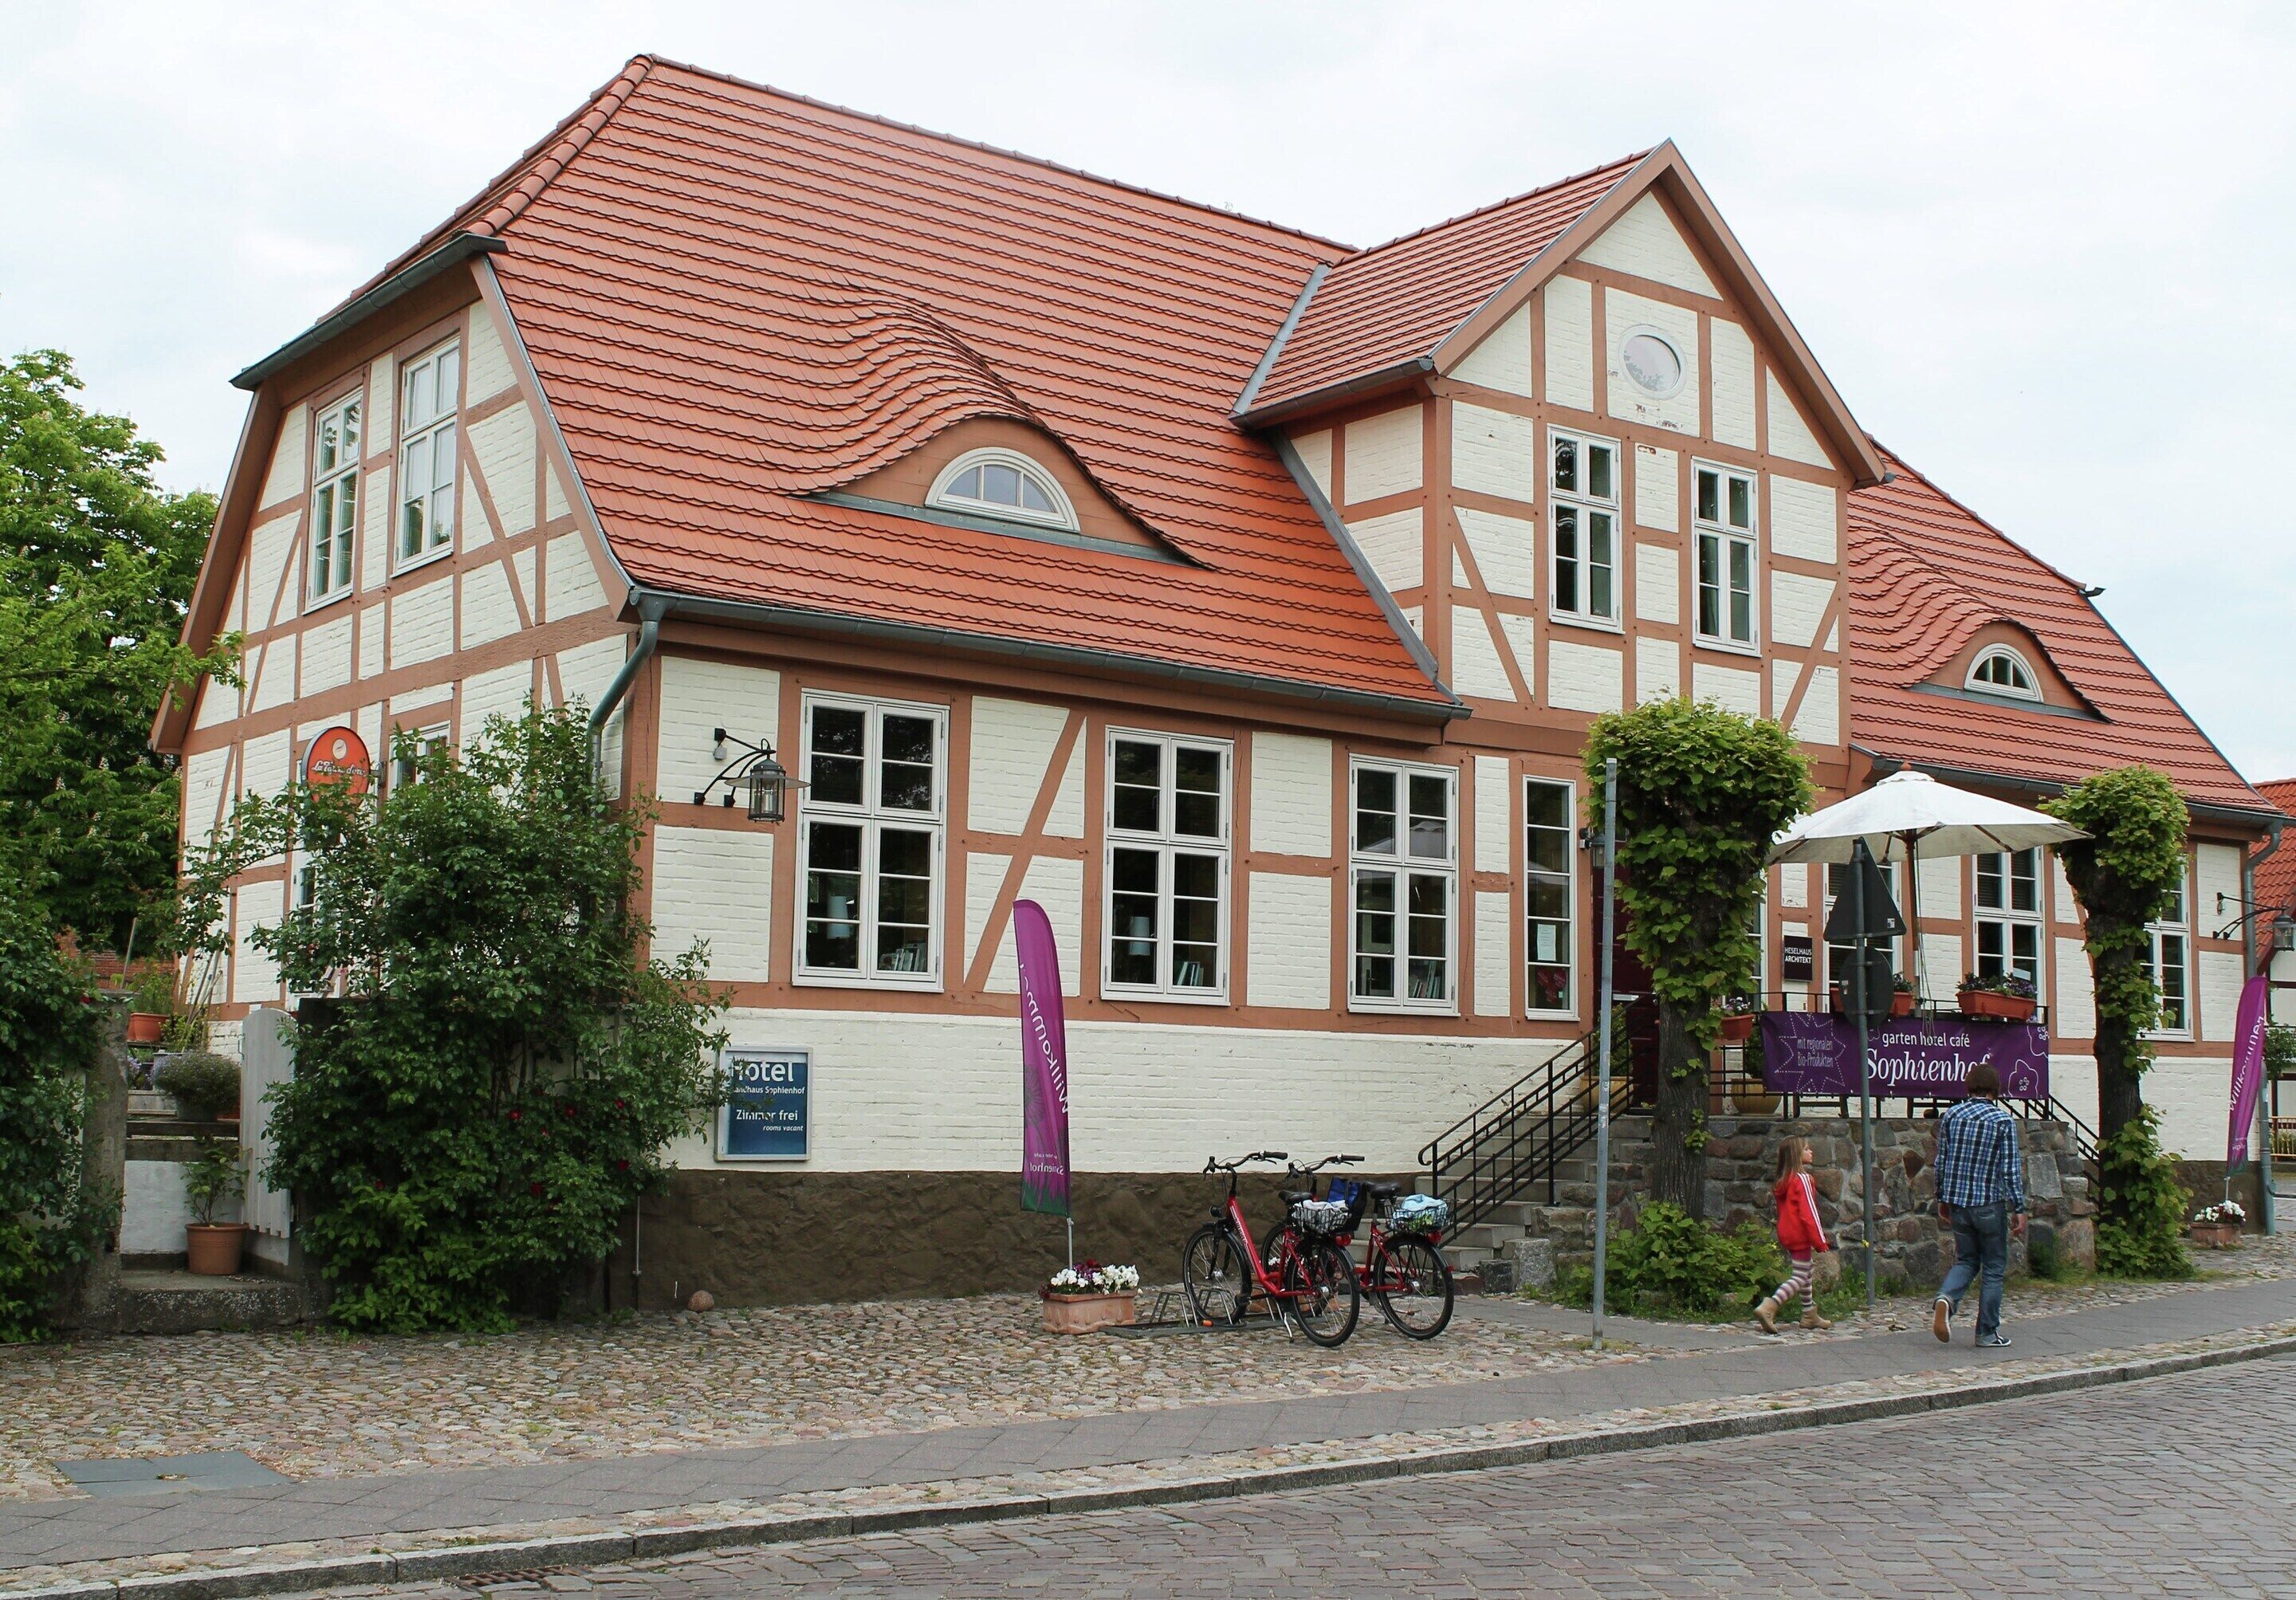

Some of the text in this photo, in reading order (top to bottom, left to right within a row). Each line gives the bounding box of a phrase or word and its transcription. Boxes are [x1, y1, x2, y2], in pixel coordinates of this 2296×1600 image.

[1784, 947, 1812, 956] HESELHAUS
[1807, 1036, 1833, 1054] regionalen
[1882, 1031, 1971, 1048] garten hotel café
[1798, 1052, 1834, 1067] Bio-Produkten
[733, 1085, 805, 1095] andhaus Sophienhof
[779, 1110, 798, 1121] frei
